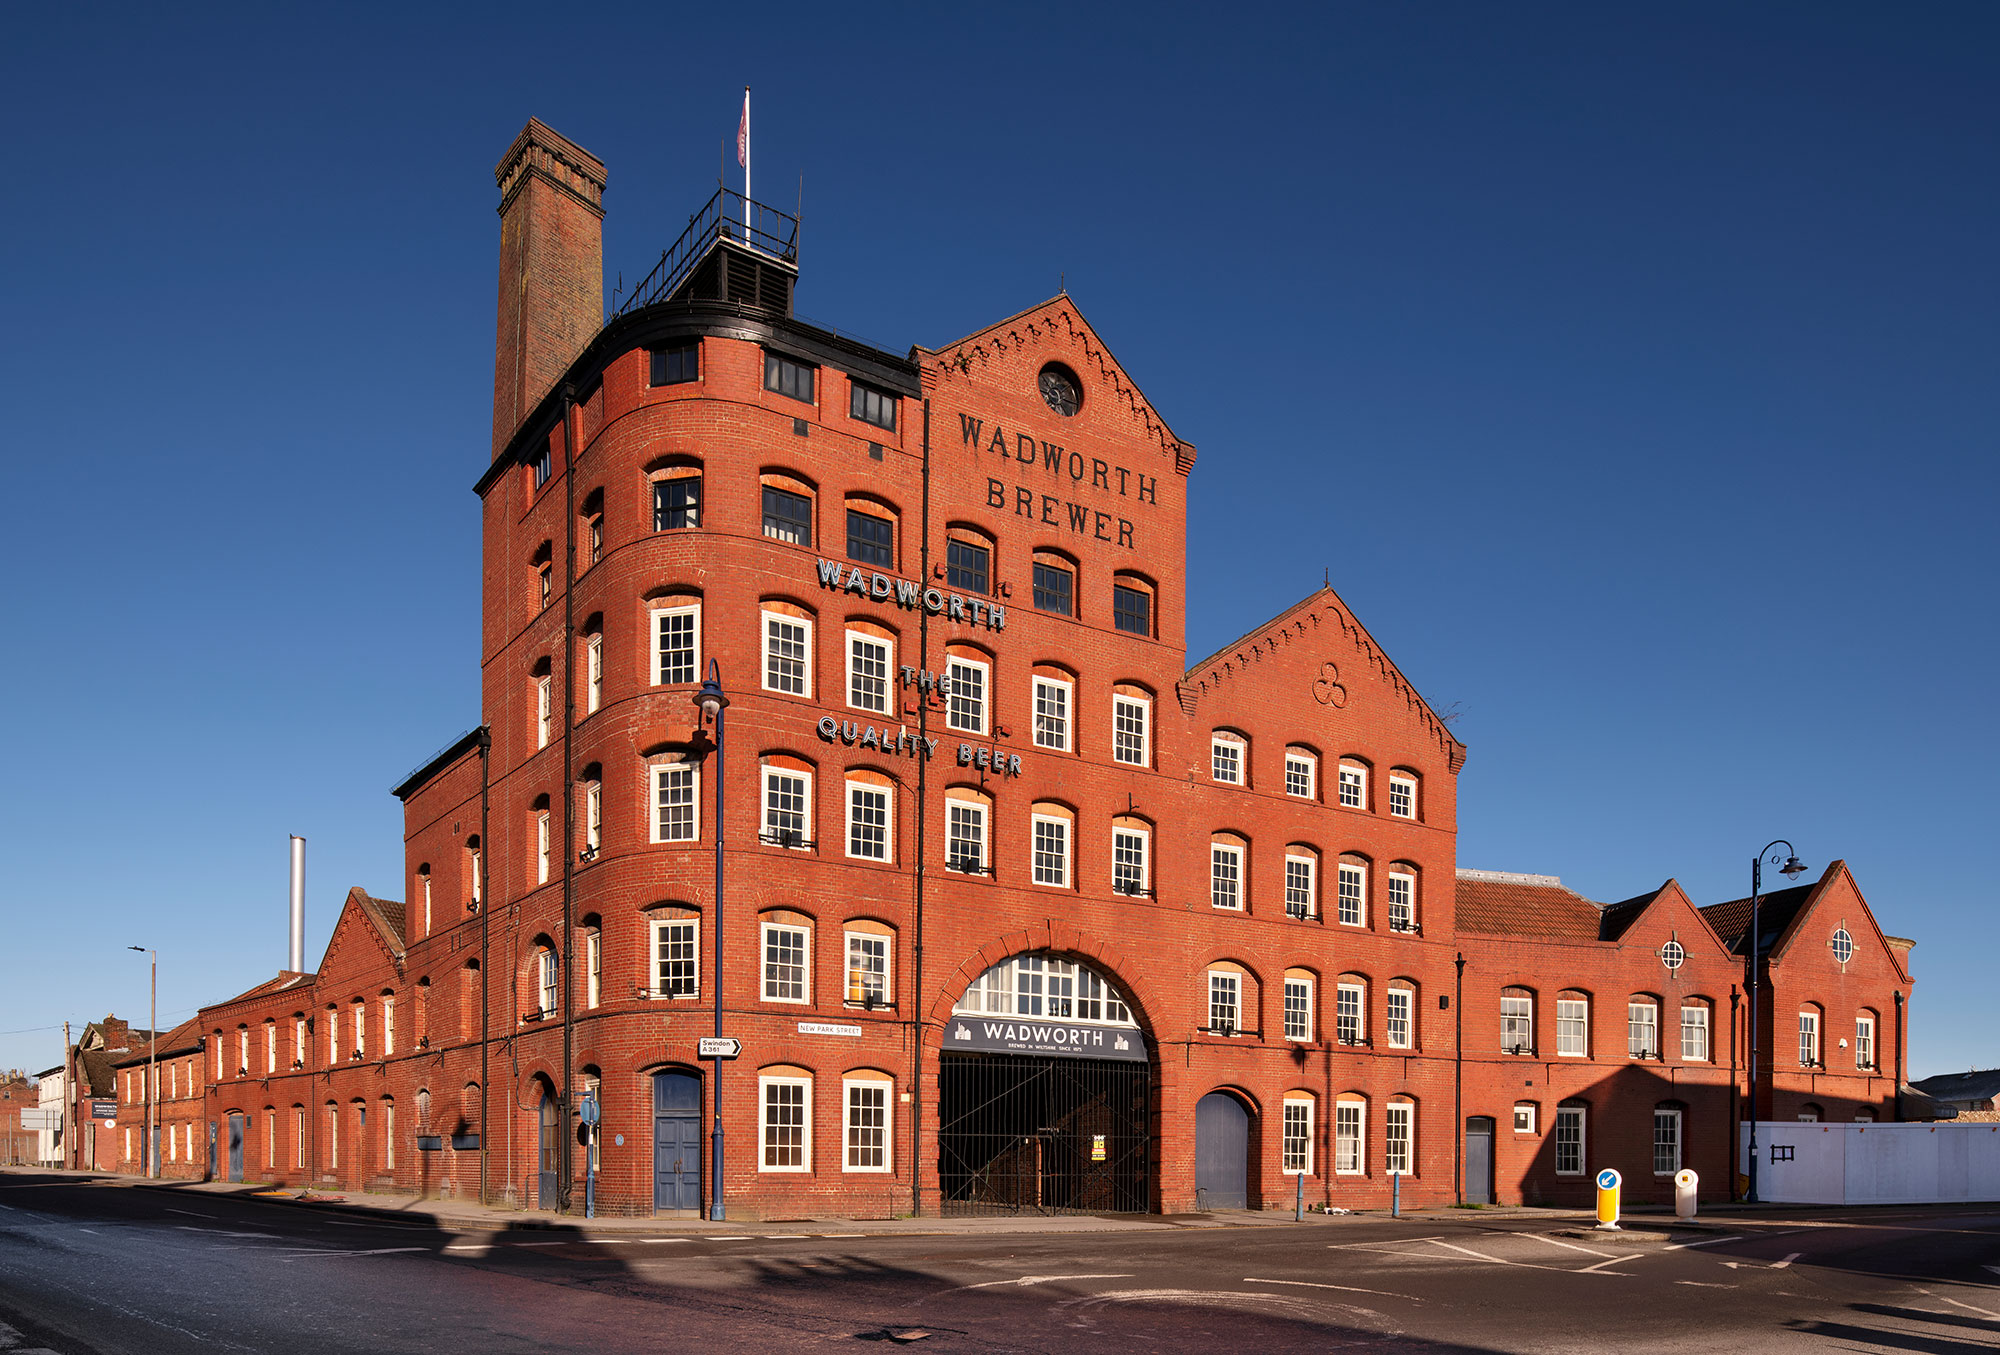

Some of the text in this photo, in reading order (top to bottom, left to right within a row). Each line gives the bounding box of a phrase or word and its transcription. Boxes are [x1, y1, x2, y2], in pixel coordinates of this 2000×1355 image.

[959, 413, 1157, 505] WADWORTH
[986, 477, 1134, 549] BREWER
[818, 558, 1005, 630] WADWORTH
[901, 665, 951, 693] THE
[818, 716, 1022, 775] QUALITY BEER
[800, 1024, 815, 1032] NEW
[817, 1025, 833, 1033] PARK
[983, 1022, 1103, 1046] WADWORTH
